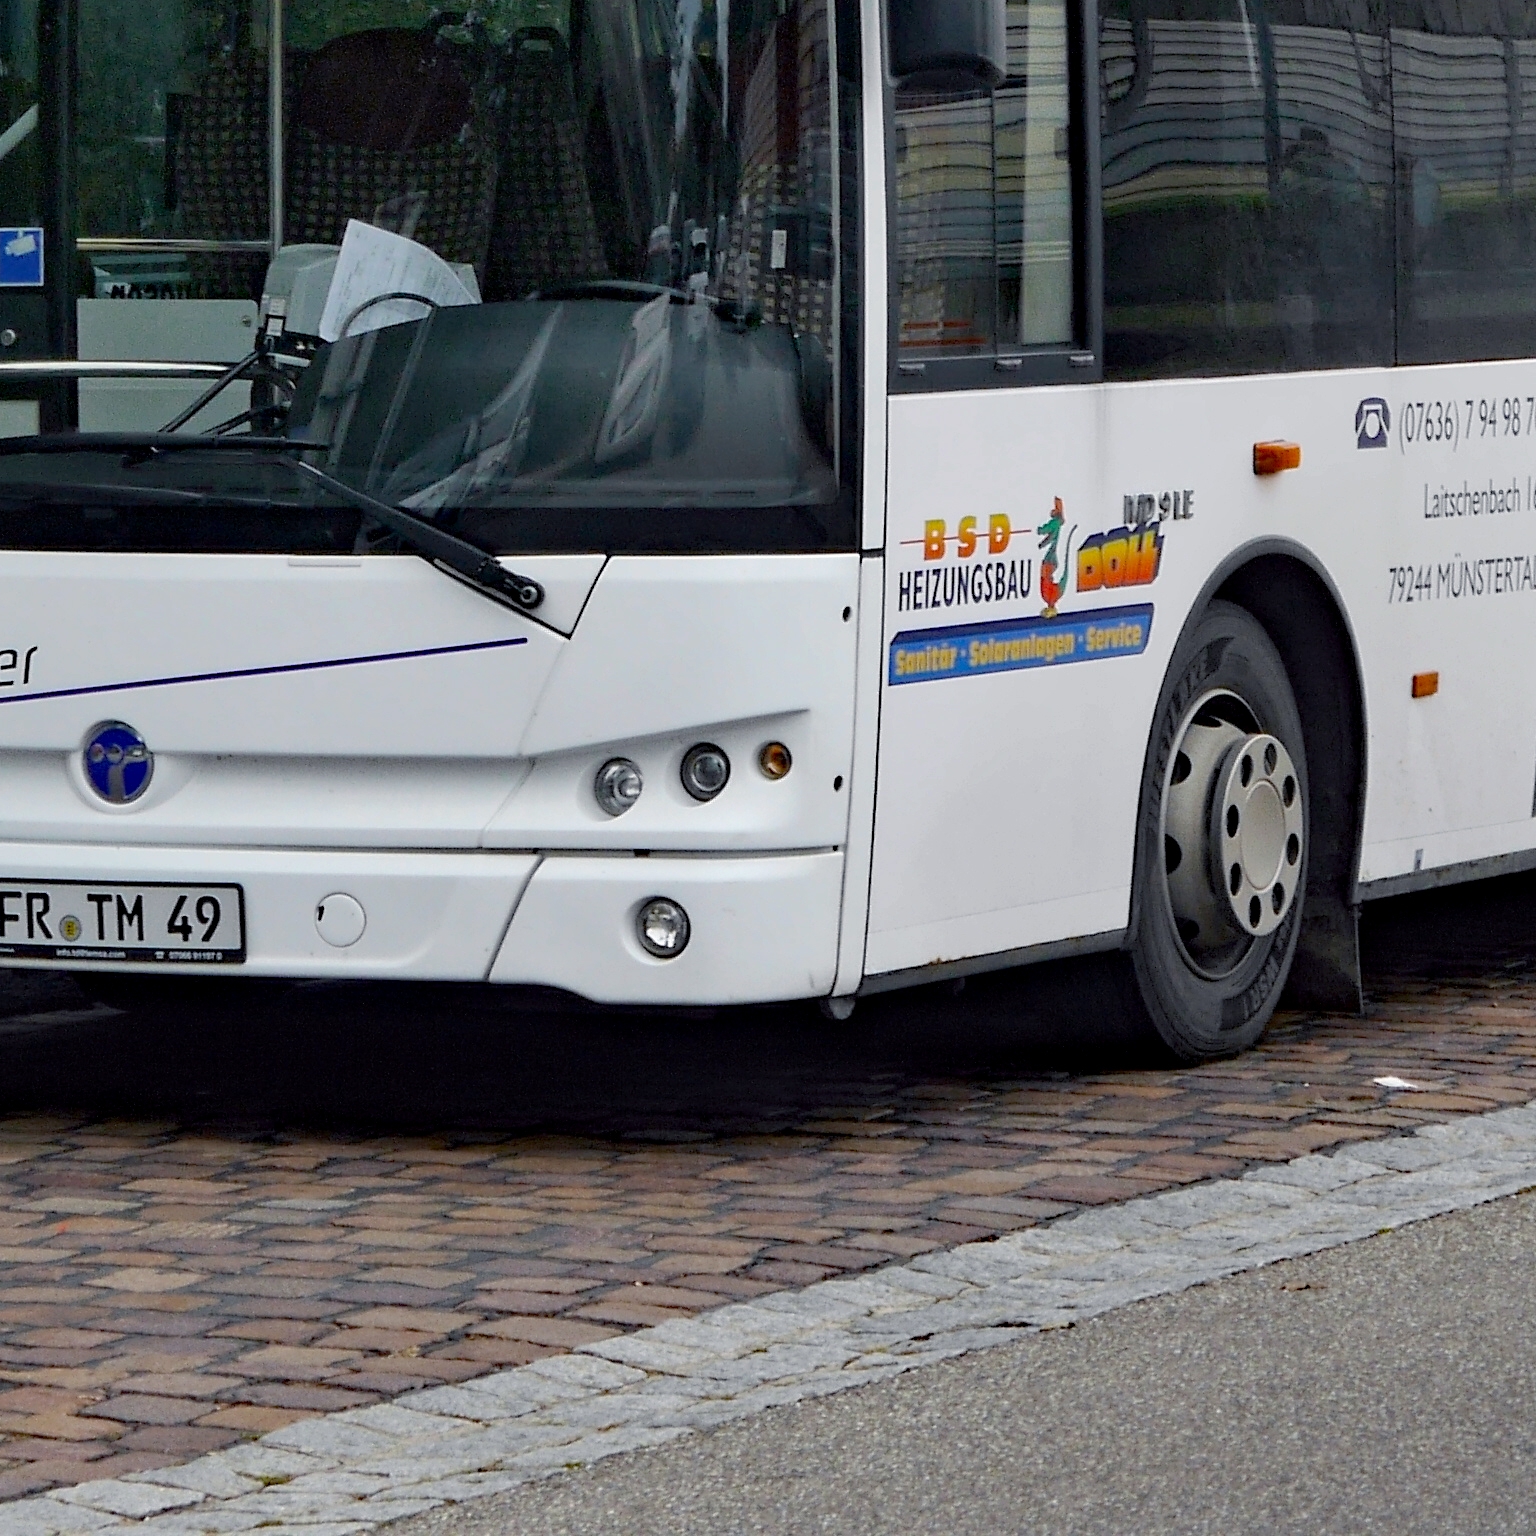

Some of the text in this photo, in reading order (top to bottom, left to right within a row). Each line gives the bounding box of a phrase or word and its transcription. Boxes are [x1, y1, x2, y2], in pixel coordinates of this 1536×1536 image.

[1398, 399, 1460, 455] (07636)
[1465, 399, 1474, 439] 7
[1478, 397, 1497, 438] 94
[1502, 396, 1522, 436] 98
[1424, 477, 1521, 519] Laitschenbach
[898, 559, 1032, 612] HEIZUNGSBAU
[1388, 564, 1432, 604] 79244
[894, 623, 1142, 676] Sanitär Solaranlagen Service
[86, 893, 145, 942] TM
[166, 894, 222, 943] 49
